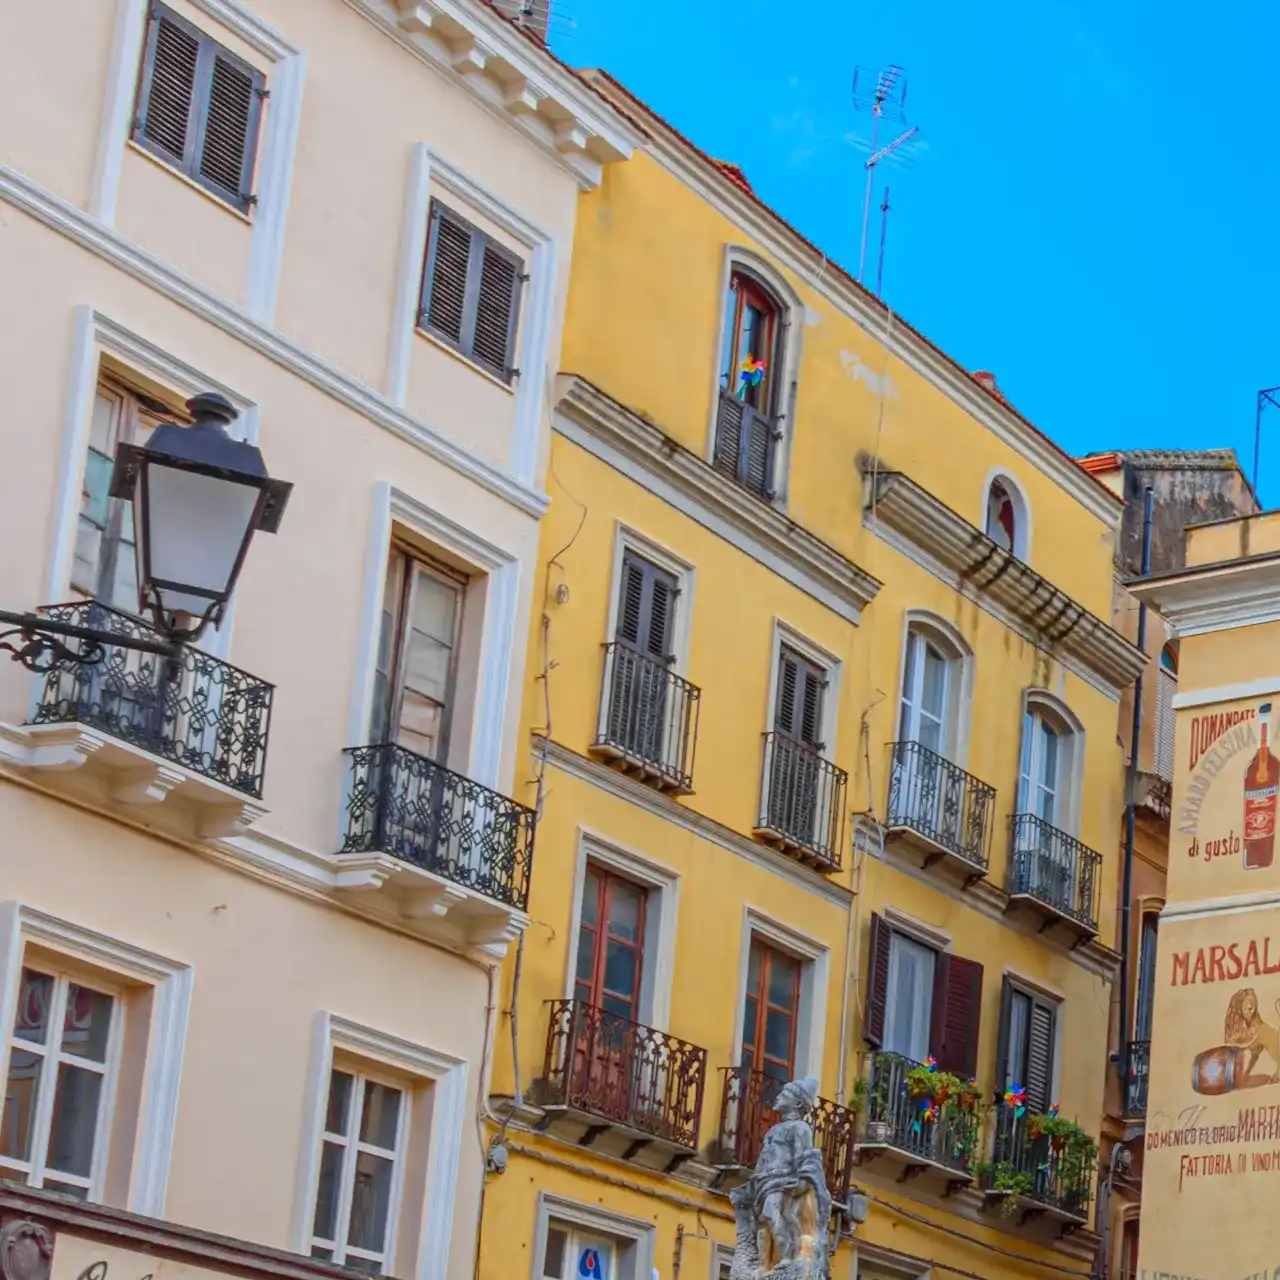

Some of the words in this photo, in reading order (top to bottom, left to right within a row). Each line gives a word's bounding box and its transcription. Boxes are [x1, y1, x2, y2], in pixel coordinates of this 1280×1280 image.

[1190, 708, 1256, 771] DOMANDATE
[1177, 775, 1211, 836] AMARO
[1188, 836, 1199, 857] di
[1204, 830, 1240, 862] gusto
[1147, 1127, 1197, 1151] DOMENICO
[1200, 1125, 1236, 1145] FLORIO
[1179, 1153, 1232, 1193] FATTORIA
[1252, 1152, 1270, 1172] VINO
